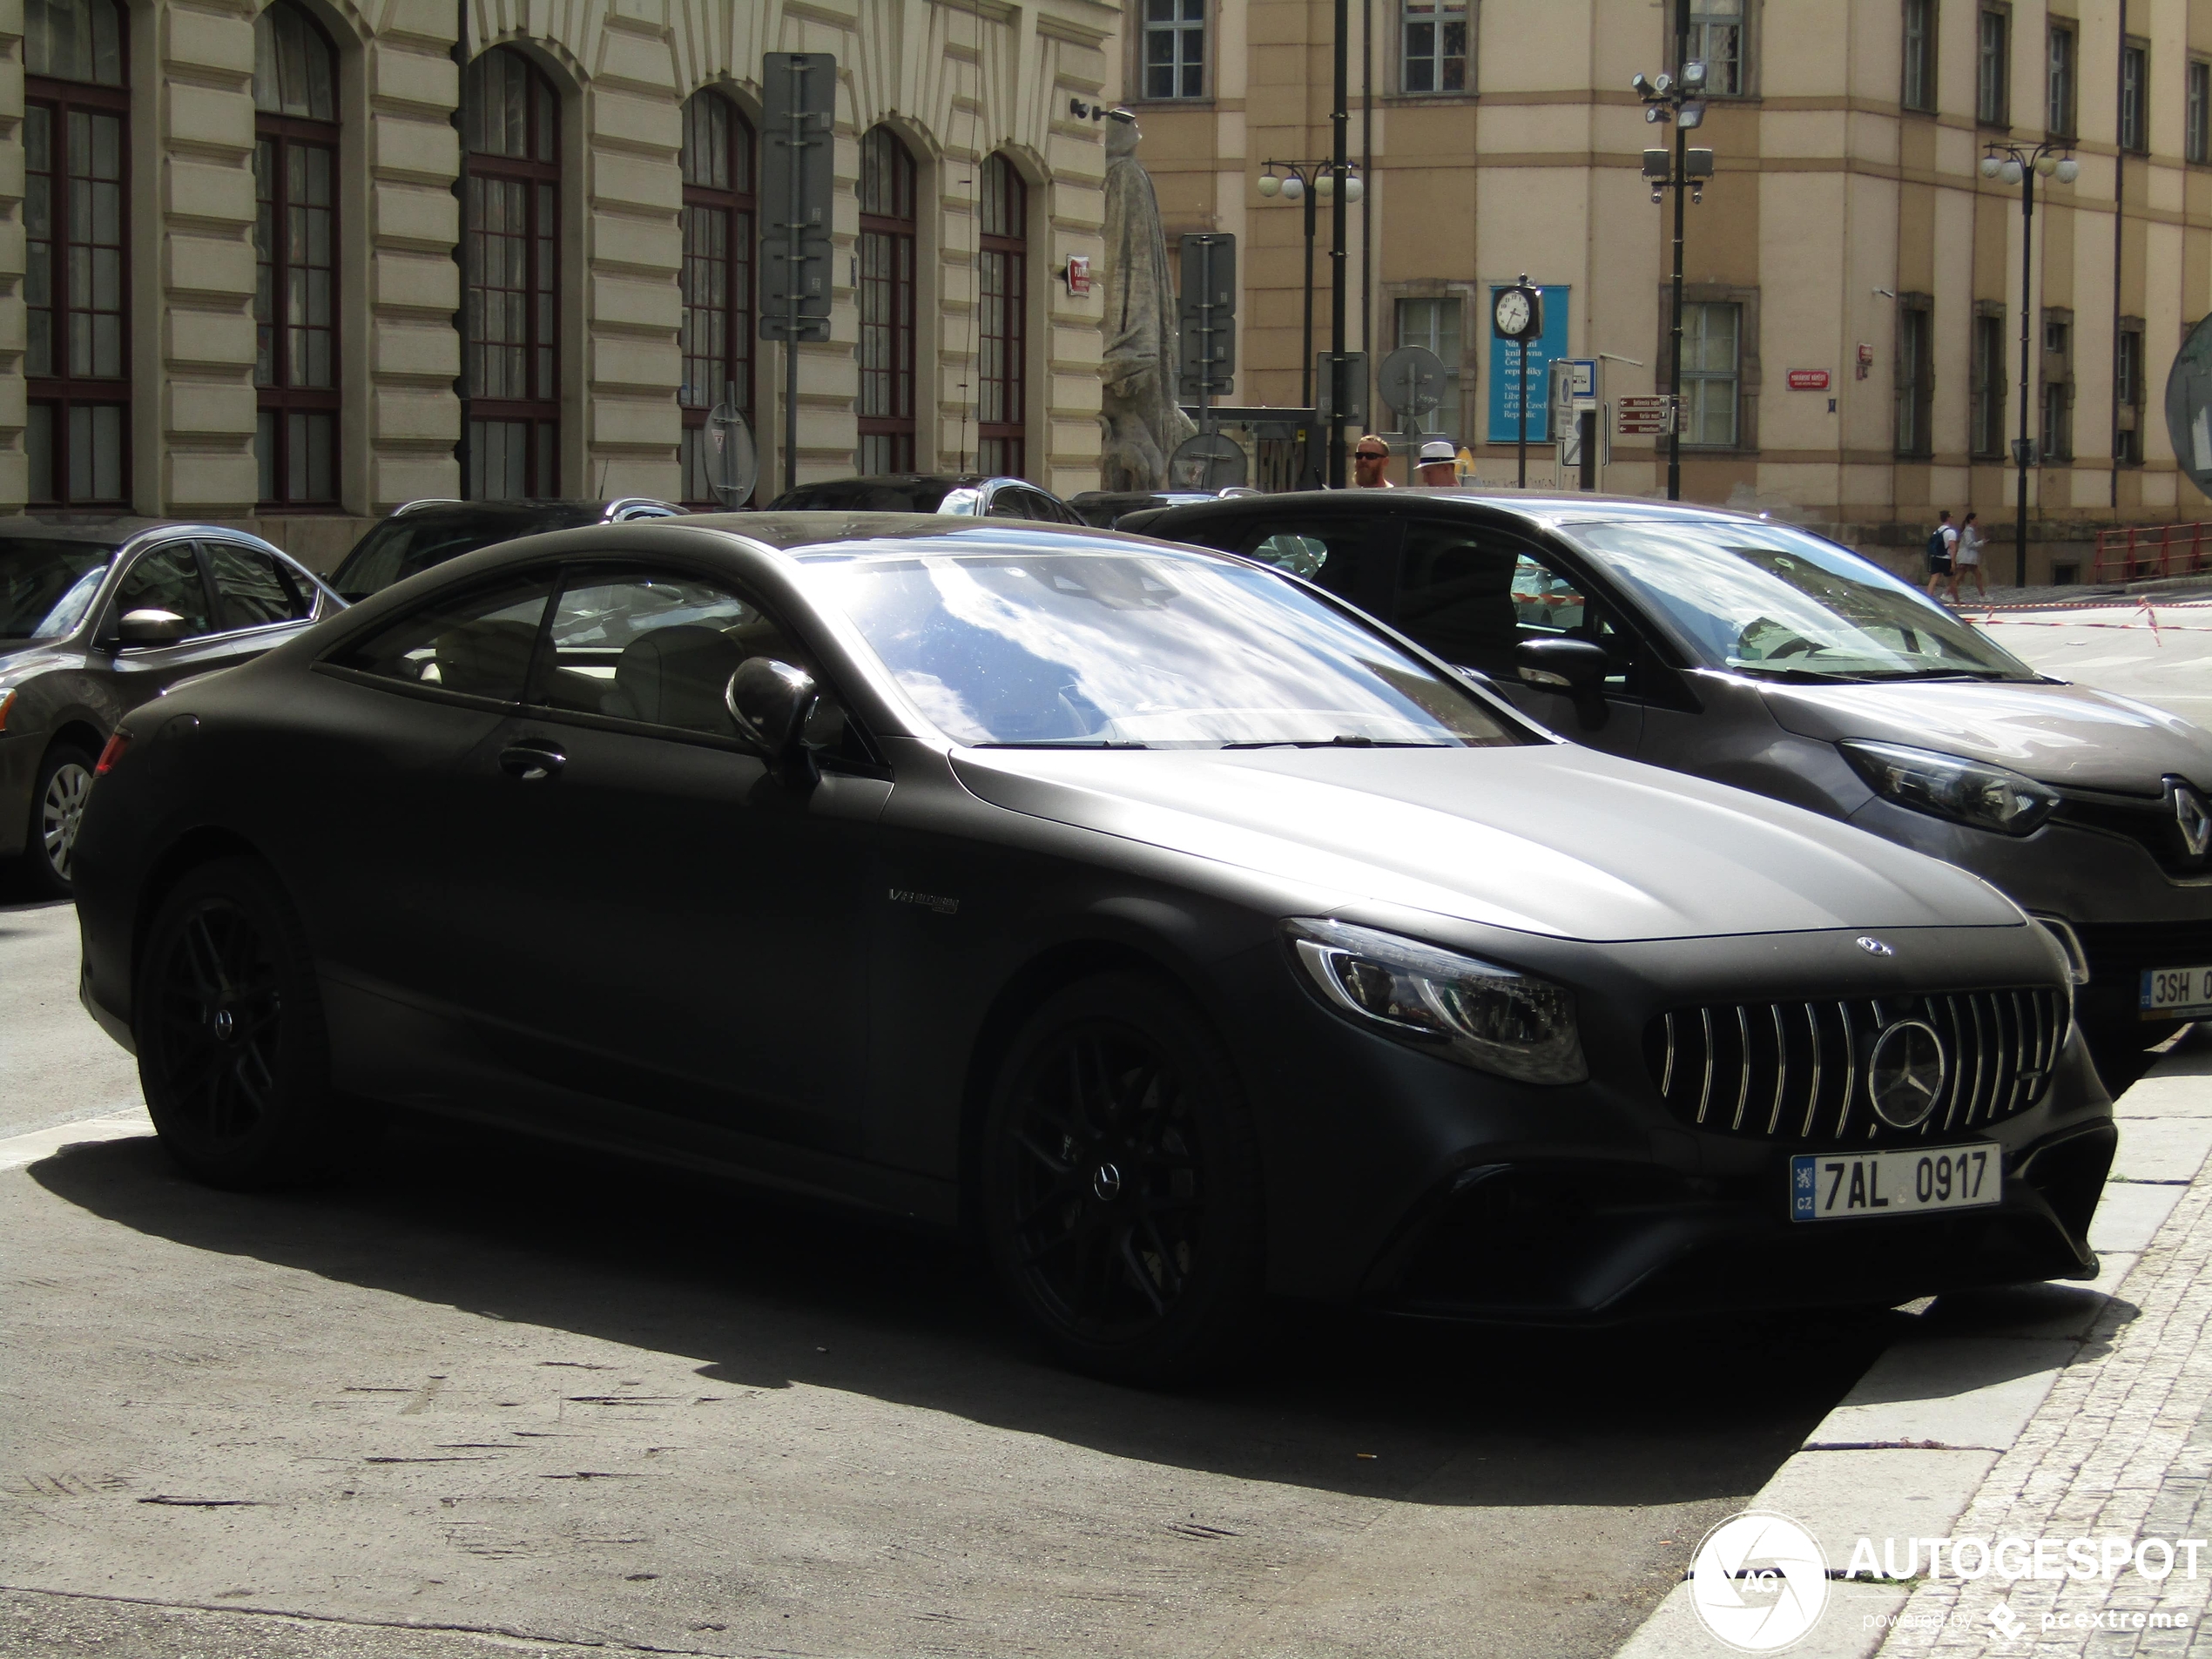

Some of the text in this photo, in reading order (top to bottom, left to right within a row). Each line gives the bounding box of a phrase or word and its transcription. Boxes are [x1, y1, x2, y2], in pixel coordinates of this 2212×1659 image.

[1505, 357, 1528, 366] Čes
[1504, 392, 1531, 401] Libry
[2155, 972, 2190, 1003] 3SH
[1824, 1151, 1987, 1211] 7AL 0917
[1797, 1197, 1812, 1211] CZ
